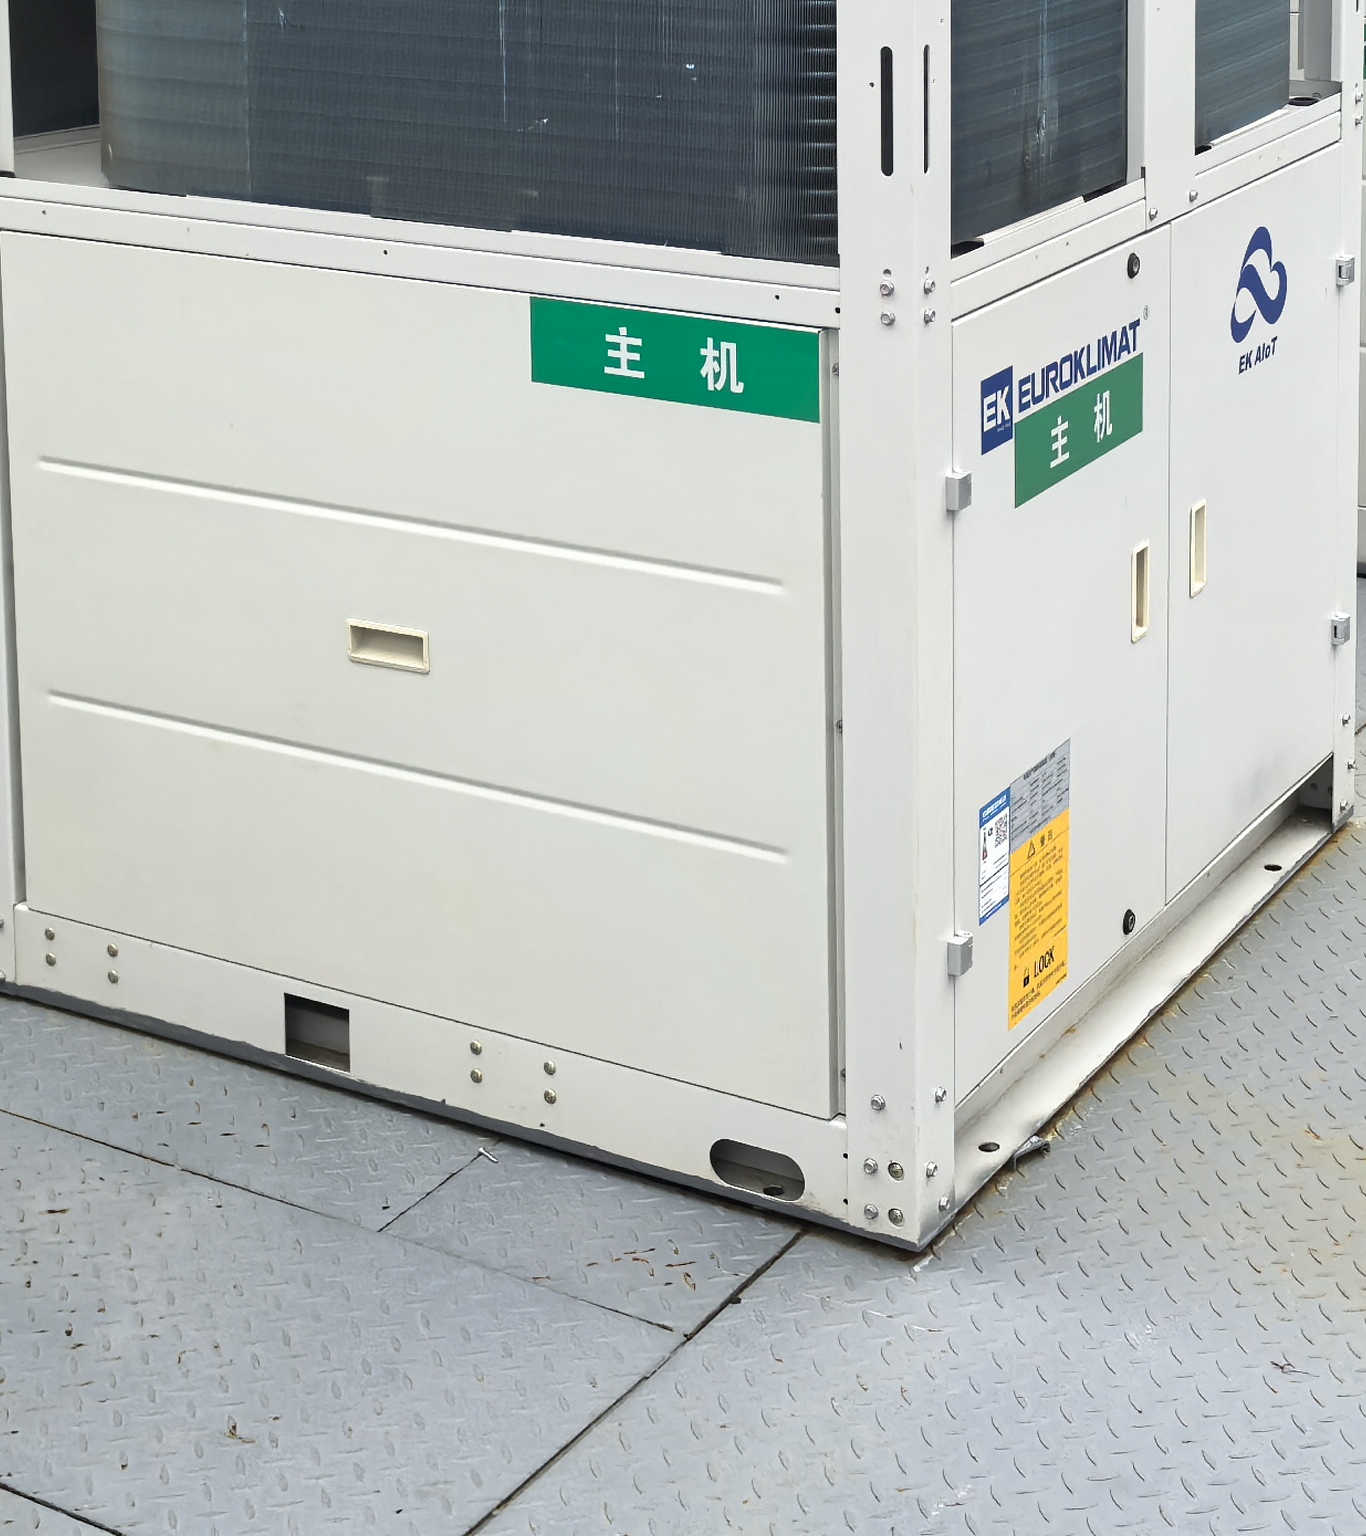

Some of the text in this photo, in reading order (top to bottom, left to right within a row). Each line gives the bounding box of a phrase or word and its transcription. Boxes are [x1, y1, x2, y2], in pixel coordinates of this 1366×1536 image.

[1238, 336, 1278, 375] EK AIoT
[983, 318, 1141, 433] EK EUROKLIMAT
[1033, 944, 1055, 980] LOCK
